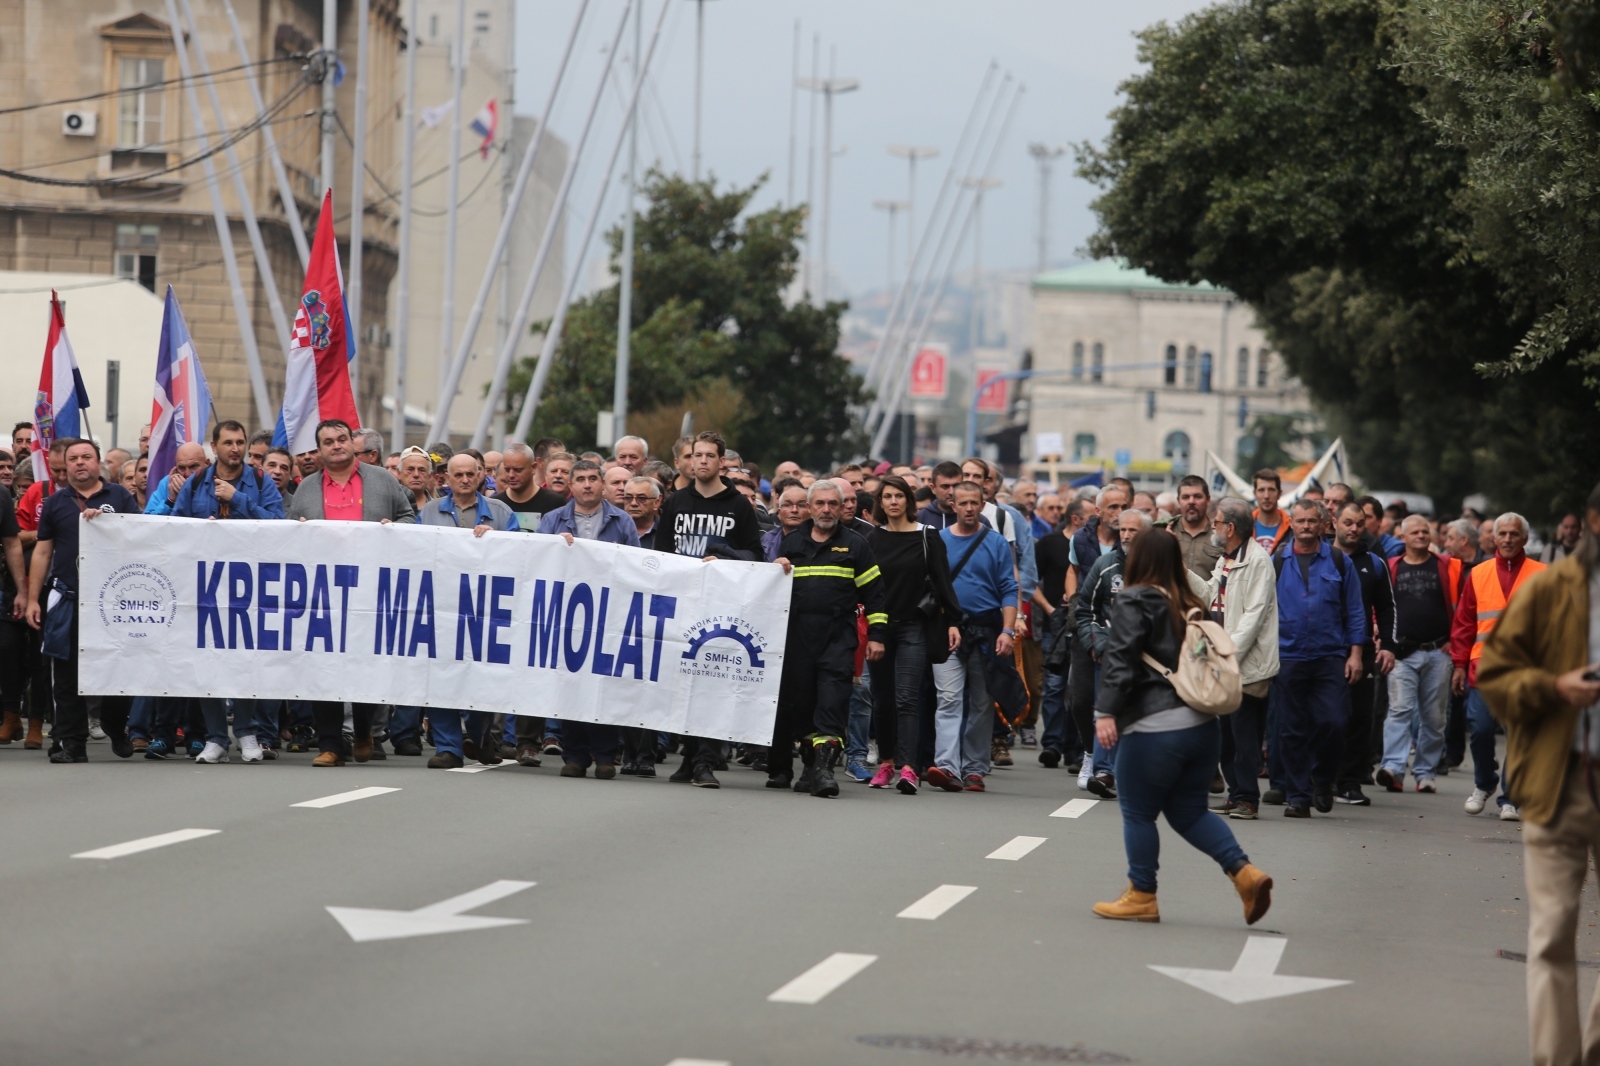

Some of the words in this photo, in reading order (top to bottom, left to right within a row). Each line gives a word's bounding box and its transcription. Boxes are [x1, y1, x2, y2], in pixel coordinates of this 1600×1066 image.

[674, 513, 736, 537] CNTMP
[99, 571, 118, 599] METALACA
[117, 563, 147, 573] HRVATSKE
[119, 599, 159, 611] SMH-IS
[113, 615, 166, 624] 3.MAJ
[197, 560, 359, 653] KREPAT
[374, 566, 437, 659] MA
[456, 573, 515, 665] NE
[528, 579, 677, 683] MOLAT
[128, 631, 148, 639] RIJEKA
[683, 616, 724, 639] SINDIKAT
[726, 616, 768, 649] METALACA
[704, 652, 743, 666] SMH-IS
[679, 667, 729, 680] INDUSTRIJSKI
[731, 674, 765, 683] SINDIKAT
[680, 660, 765, 676] HRVATSKE
